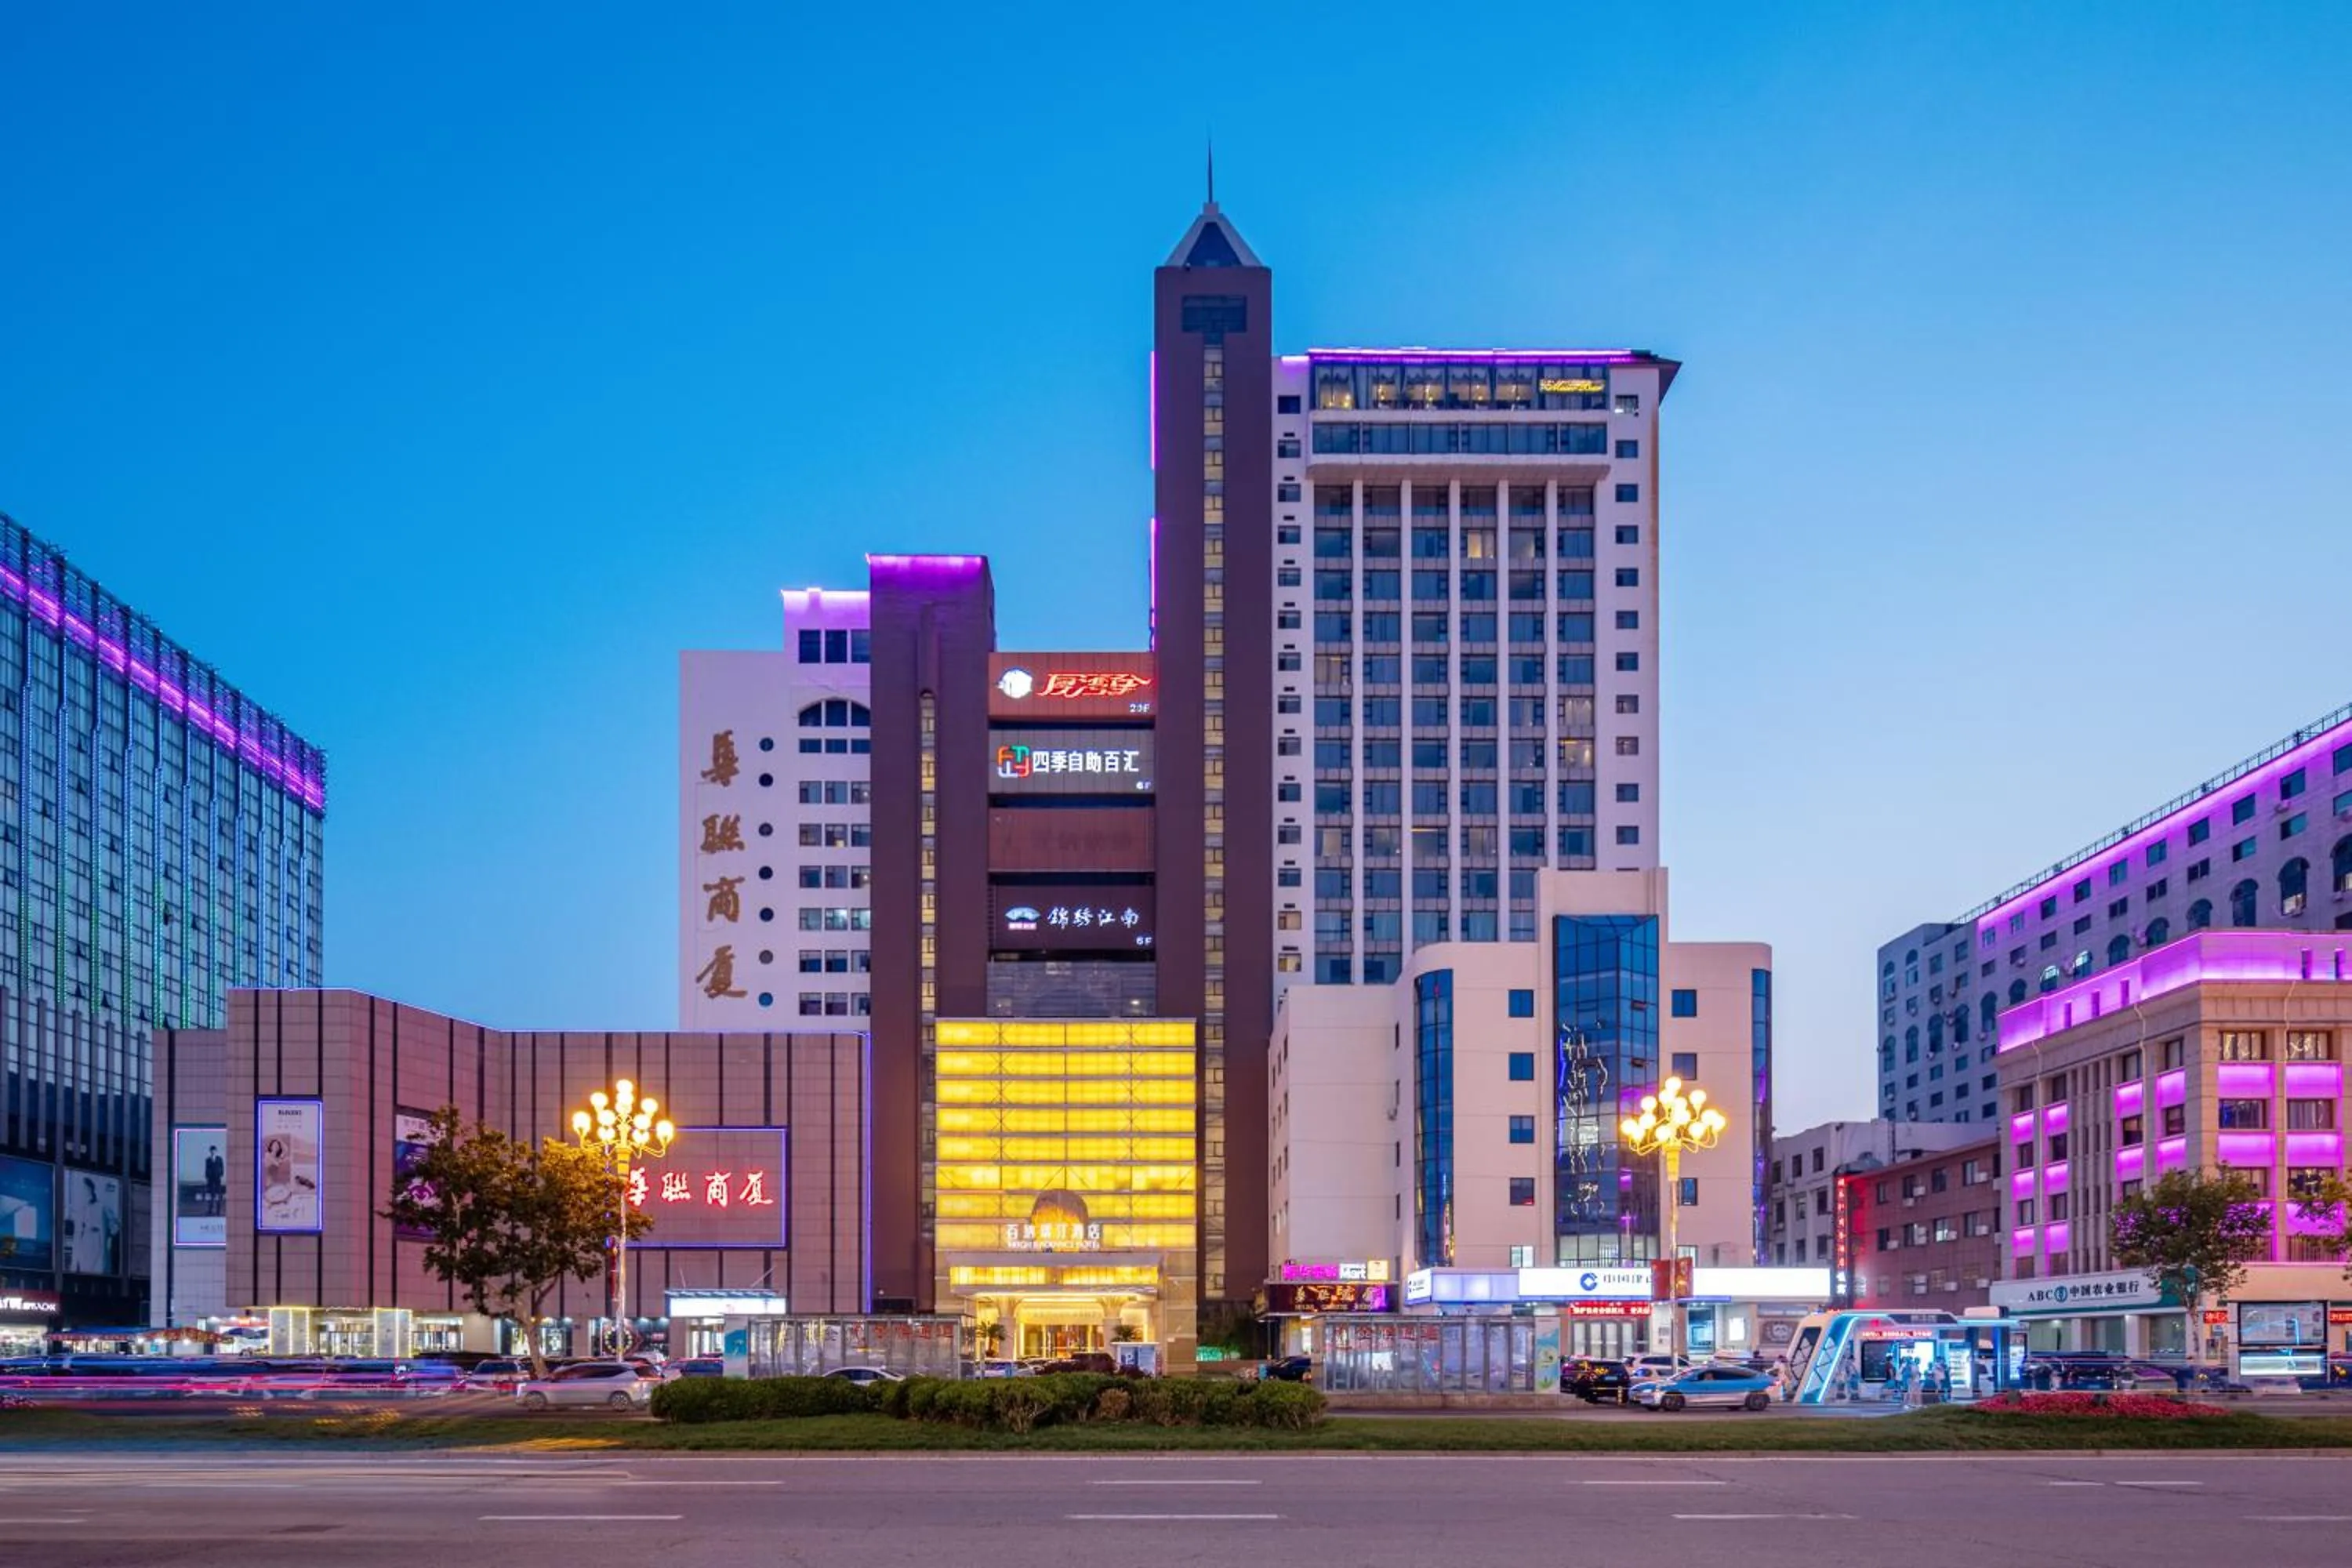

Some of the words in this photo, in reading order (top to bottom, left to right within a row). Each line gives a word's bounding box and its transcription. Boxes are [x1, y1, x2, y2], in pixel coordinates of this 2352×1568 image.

[1033, 750, 1140, 773] 四季自助百汇
[2028, 1290, 2053, 1301] ABC
[2070, 1280, 2139, 1297] 中国农业银行
